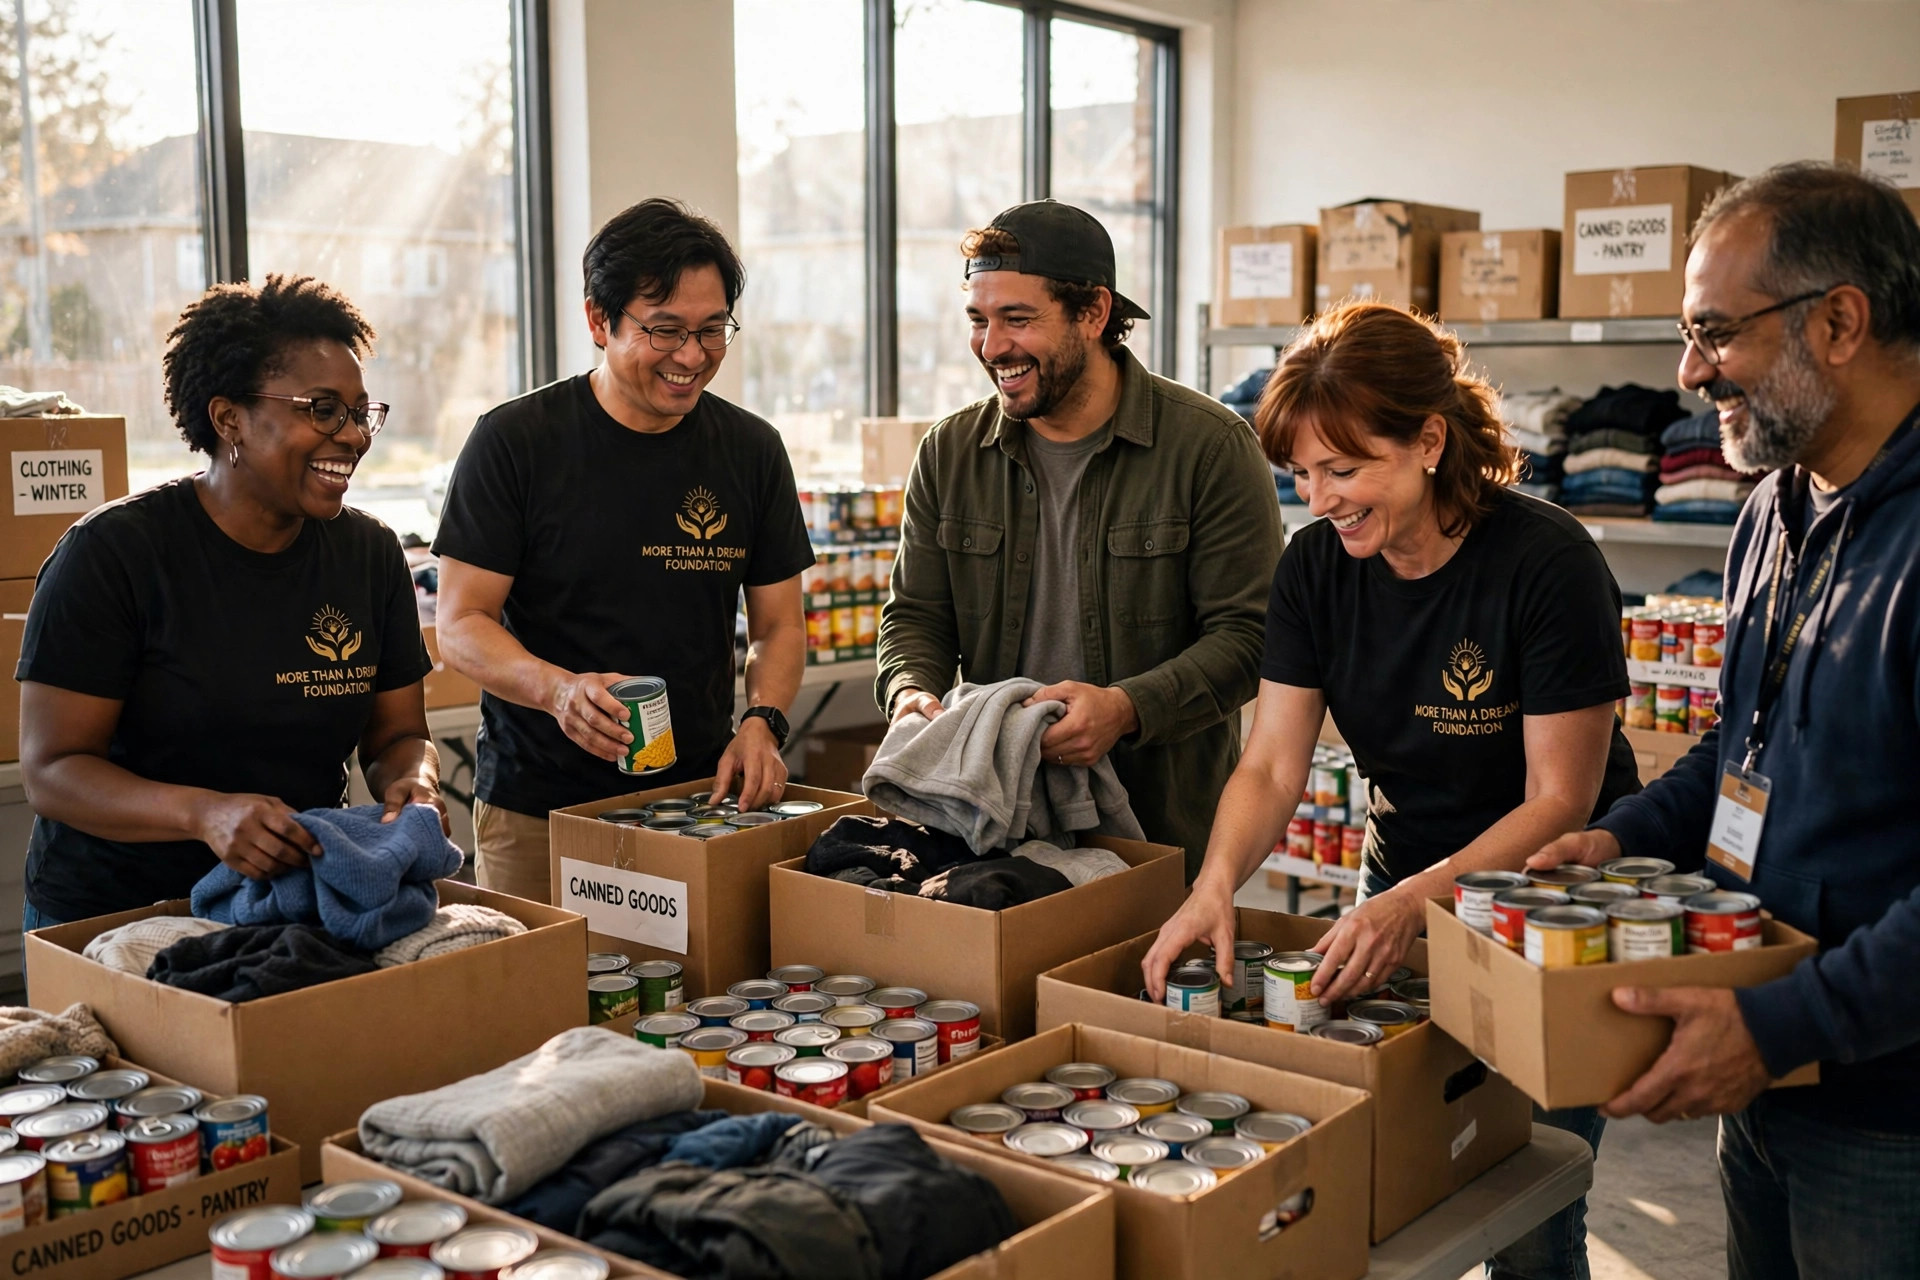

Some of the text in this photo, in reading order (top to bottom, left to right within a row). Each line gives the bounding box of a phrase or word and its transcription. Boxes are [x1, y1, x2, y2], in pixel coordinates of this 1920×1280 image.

[1578, 217, 1666, 239] CANNED GOODS
[1602, 242, 1646, 259] PANTRY
[20, 459, 92, 478] CLOTHING
[31, 483, 87, 501] WINTER
[642, 545, 746, 559] MORE THAN A DREAM
[665, 559, 732, 571] FOUNDATION
[276, 671, 311, 684] MORE
[311, 668, 345, 682] THAN
[346, 667, 355, 679] A
[303, 681, 371, 698] FOUNDATION
[1414, 700, 1520, 721] MORE THAN A DREAM
[1432, 721, 1503, 736] FOUNDATION
[570, 876, 678, 918] CANNED GOODS
[11, 1176, 270, 1276] CANNED GOODS - PANTRY
